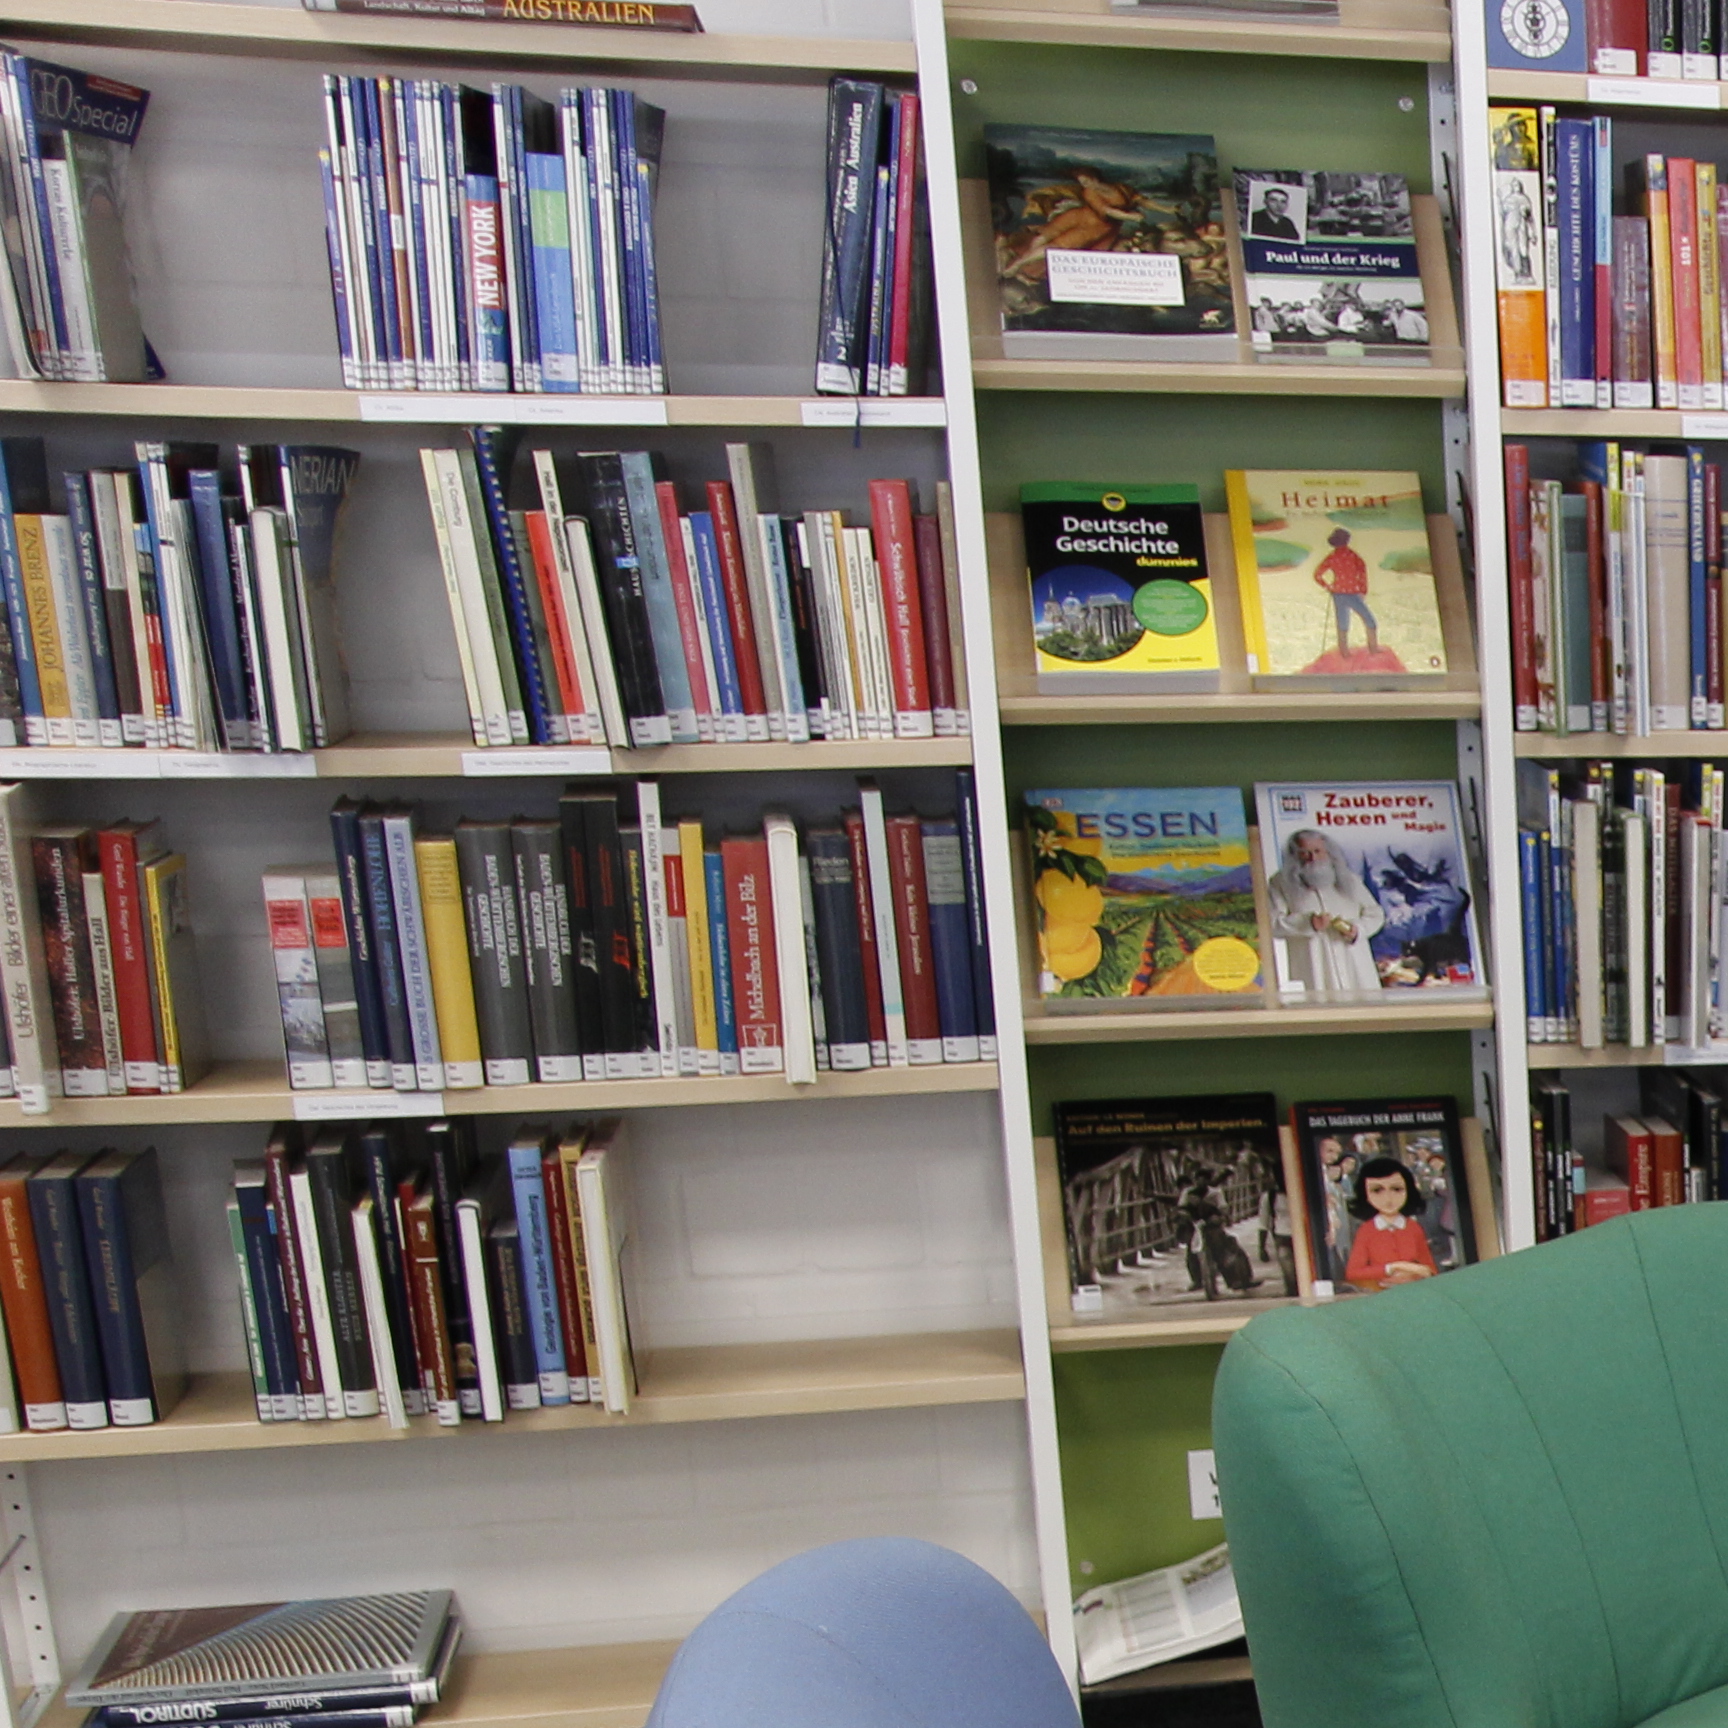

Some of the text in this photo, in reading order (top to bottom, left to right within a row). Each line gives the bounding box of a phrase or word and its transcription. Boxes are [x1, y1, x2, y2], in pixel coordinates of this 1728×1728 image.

[503, 0, 655, 25] AUSTRALIEN
[844, 102, 863, 213] Asien Australien
[1569, 187, 1581, 209] DES
[470, 204, 501, 308] NEW YORK
[1264, 250, 1401, 271] Paul und der Krieg
[1569, 213, 1581, 282] GESCHICHTE
[445, 471, 464, 528] Die Comburg
[1280, 489, 1391, 509] Heimat
[1061, 516, 1169, 535] Deutsche
[1054, 535, 1179, 555] Geschichte
[1135, 555, 1197, 568] dummies
[24, 528, 54, 671] JOHANNES BRENZ
[1323, 792, 1434, 809] Zauberer,
[1073, 811, 1218, 839] ESSEN
[1315, 811, 1386, 827] Hexen
[1403, 821, 1446, 833] Magie
[396, 832, 408, 854] ALB
[50, 847, 74, 943] Spitalurkunden
[367, 834, 393, 931] HOHENLOHE
[90, 916, 106, 947] Hall
[95, 948, 109, 971] aus
[740, 874, 766, 1021] Michelbach an der Bilz
[62, 945, 81, 983] Haller
[408, 951, 423, 974] DER
[97, 973, 114, 1014] Bilder
[411, 976, 428, 1009] BUCH
[415, 1011, 432, 1055] GROSSE
[1124, 1121, 1173, 1134] Ruinen
[1308, 1110, 1444, 1127] DAS TAGEBUCH DER ANNE FRANK
[530, 1194, 558, 1355] Geologie von Baden-Württemberg
[132, 1694, 324, 1724] Schnürer SÜDTIROL
